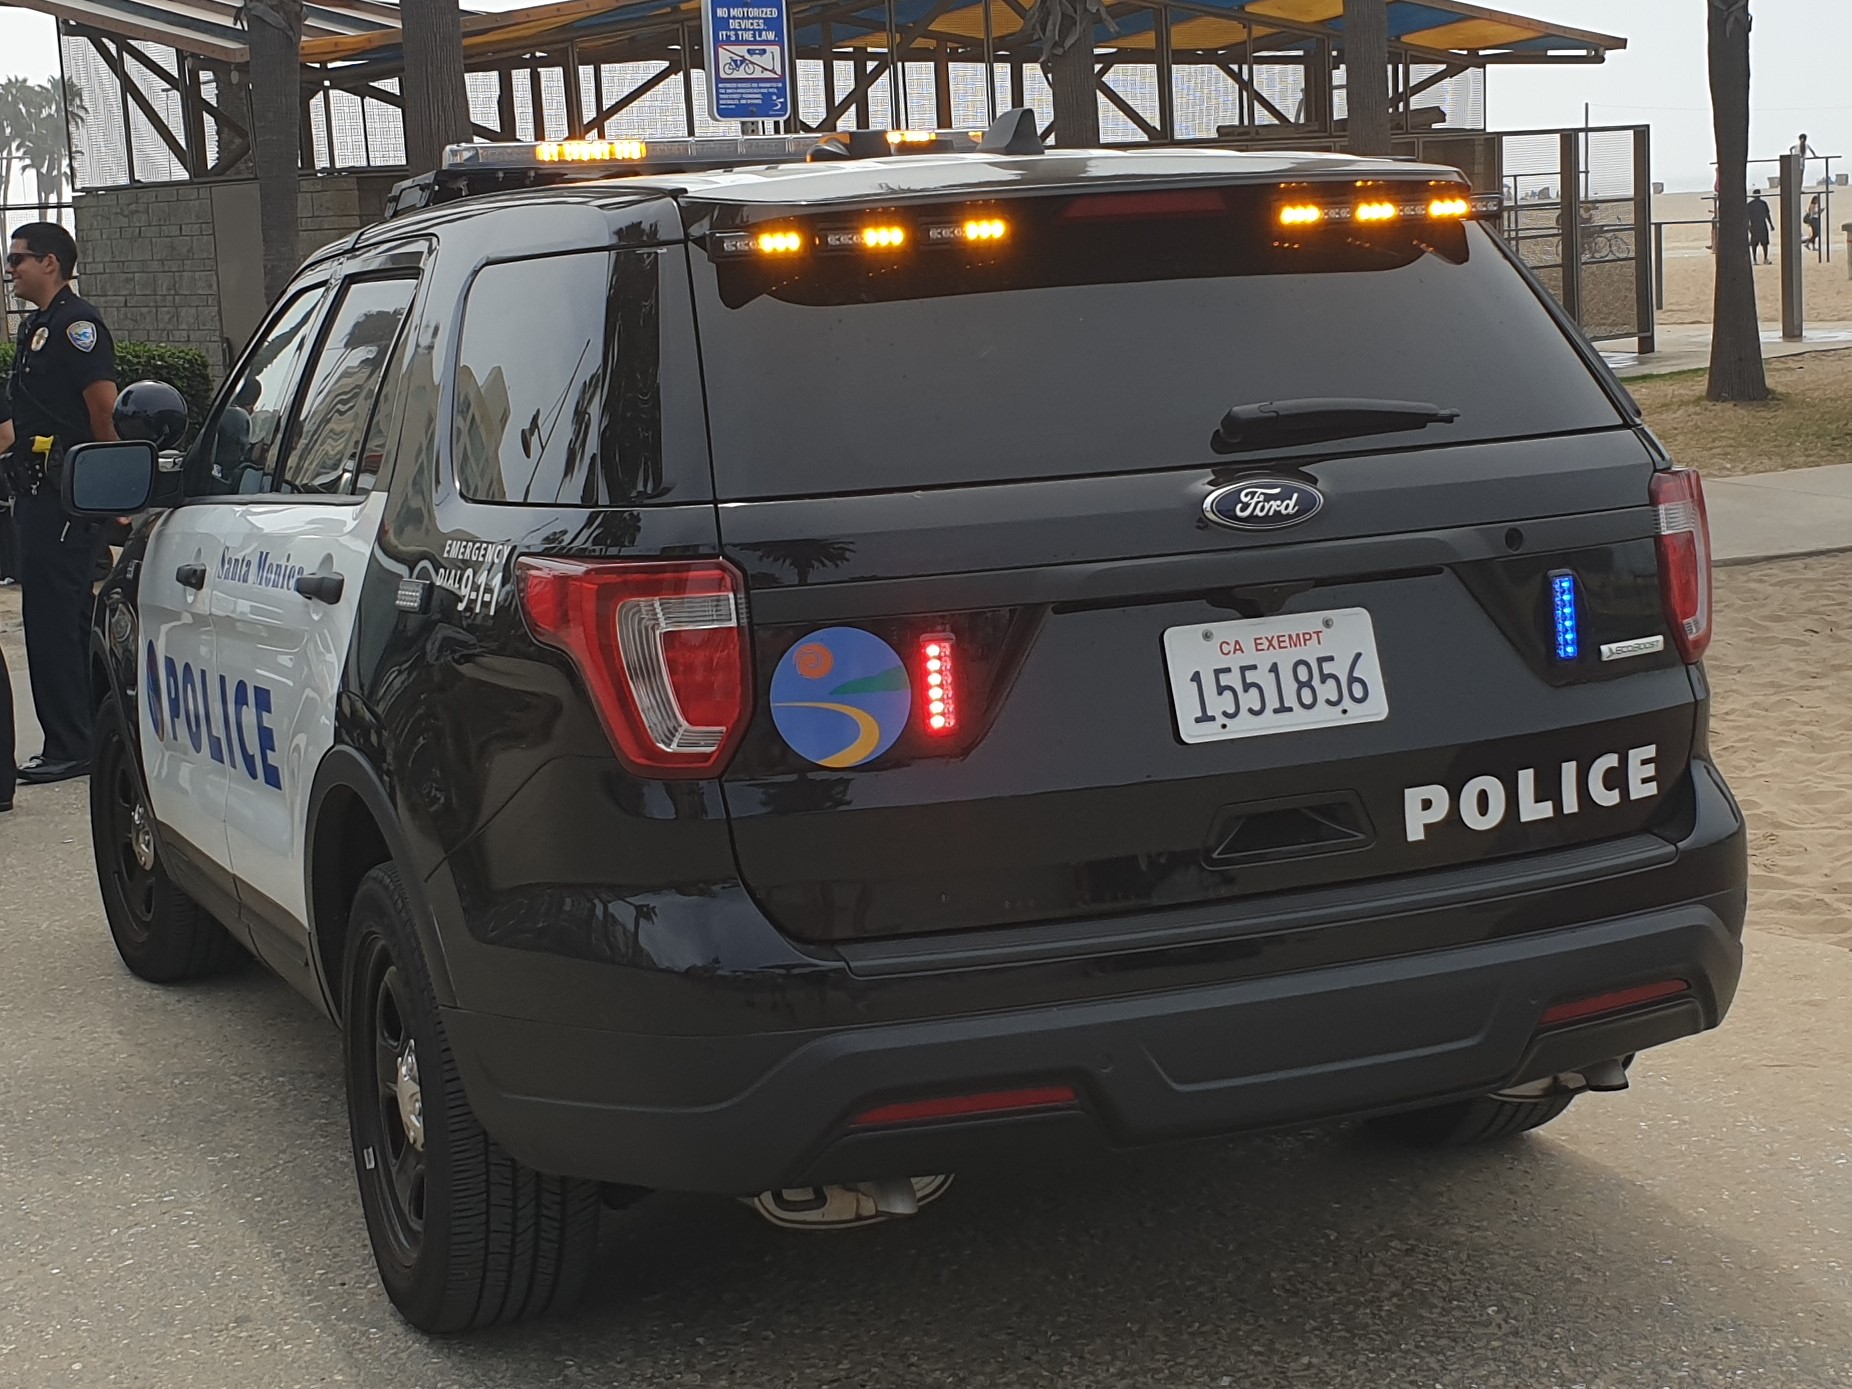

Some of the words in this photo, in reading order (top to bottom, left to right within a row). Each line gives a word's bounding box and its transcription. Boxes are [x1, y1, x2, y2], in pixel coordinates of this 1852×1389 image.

[716, 7, 728, 17] NO
[730, 7, 778, 17] MOTORIZED
[729, 19, 767, 29] DEVICES.
[718, 30, 736, 41] IT'S
[737, 30, 754, 41] THE
[756, 30, 778, 41] LAW.
[1235, 487, 1298, 518] Ford
[217, 546, 252, 584] Santa
[443, 539, 512, 564] EMERGENCY
[436, 567, 461, 588] DIAL
[457, 567, 503, 616] 9-1-1
[1219, 640, 1244, 656] CA
[1253, 630, 1323, 652] EXEMPT
[1189, 651, 1369, 724] 1551856
[164, 655, 283, 791] POLICE
[1403, 743, 1659, 843] POLICE
